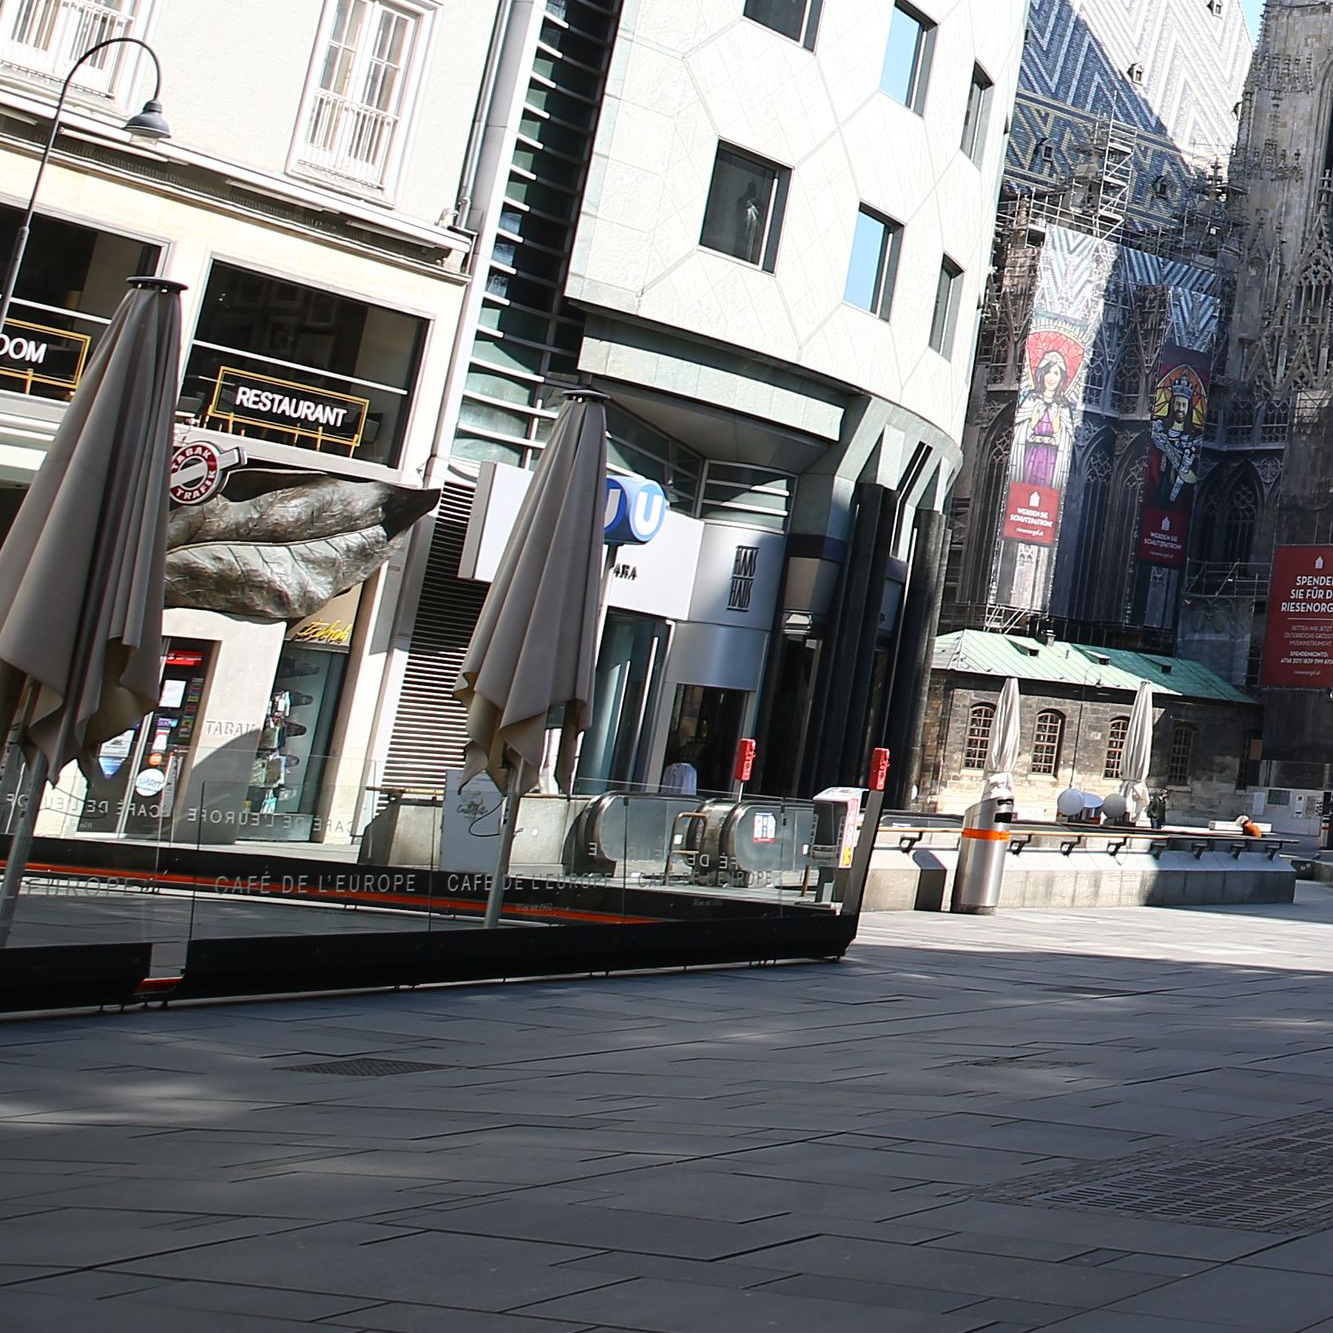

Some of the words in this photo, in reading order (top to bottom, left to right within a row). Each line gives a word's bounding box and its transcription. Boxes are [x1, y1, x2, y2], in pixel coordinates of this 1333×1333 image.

[235, 387, 347, 427] RESTAURANT
[171, 446, 211, 471] TABAK
[175, 470, 216, 500] TRAFIK
[635, 491, 660, 536] U
[1290, 589, 1304, 599] SIE
[1306, 587, 1323, 599] FÜR
[214, 870, 271, 895] CAFÉ
[282, 874, 308, 894] DE
[318, 873, 416, 894] L'EUROPE
